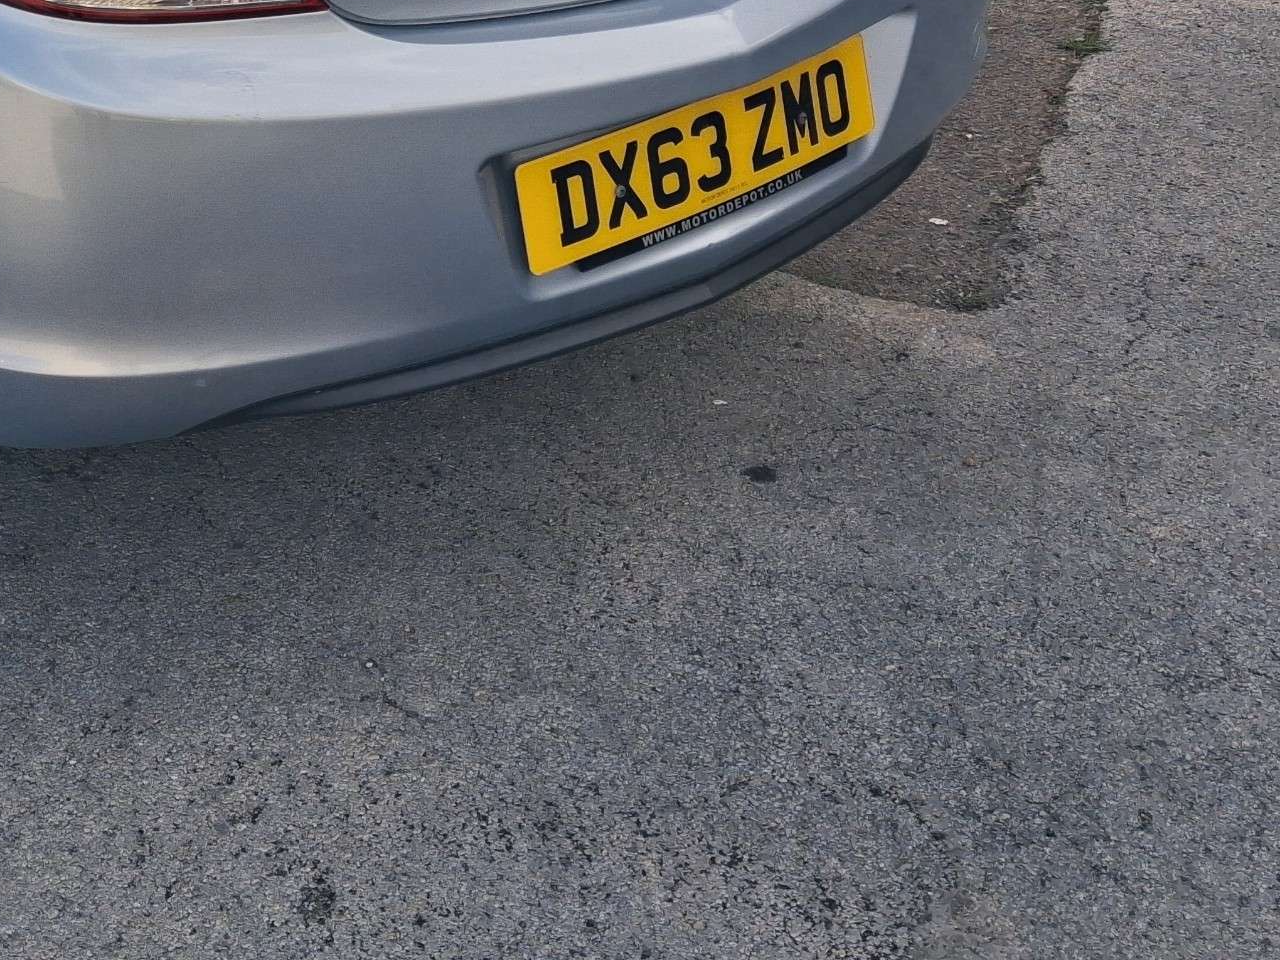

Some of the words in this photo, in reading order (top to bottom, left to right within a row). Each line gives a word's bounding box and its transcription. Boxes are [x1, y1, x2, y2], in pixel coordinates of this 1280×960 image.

[550, 110, 732, 248] DX63
[743, 58, 850, 174] ZMO
[642, 170, 803, 248] WWW.MOTORDEPOT.CO.UK
